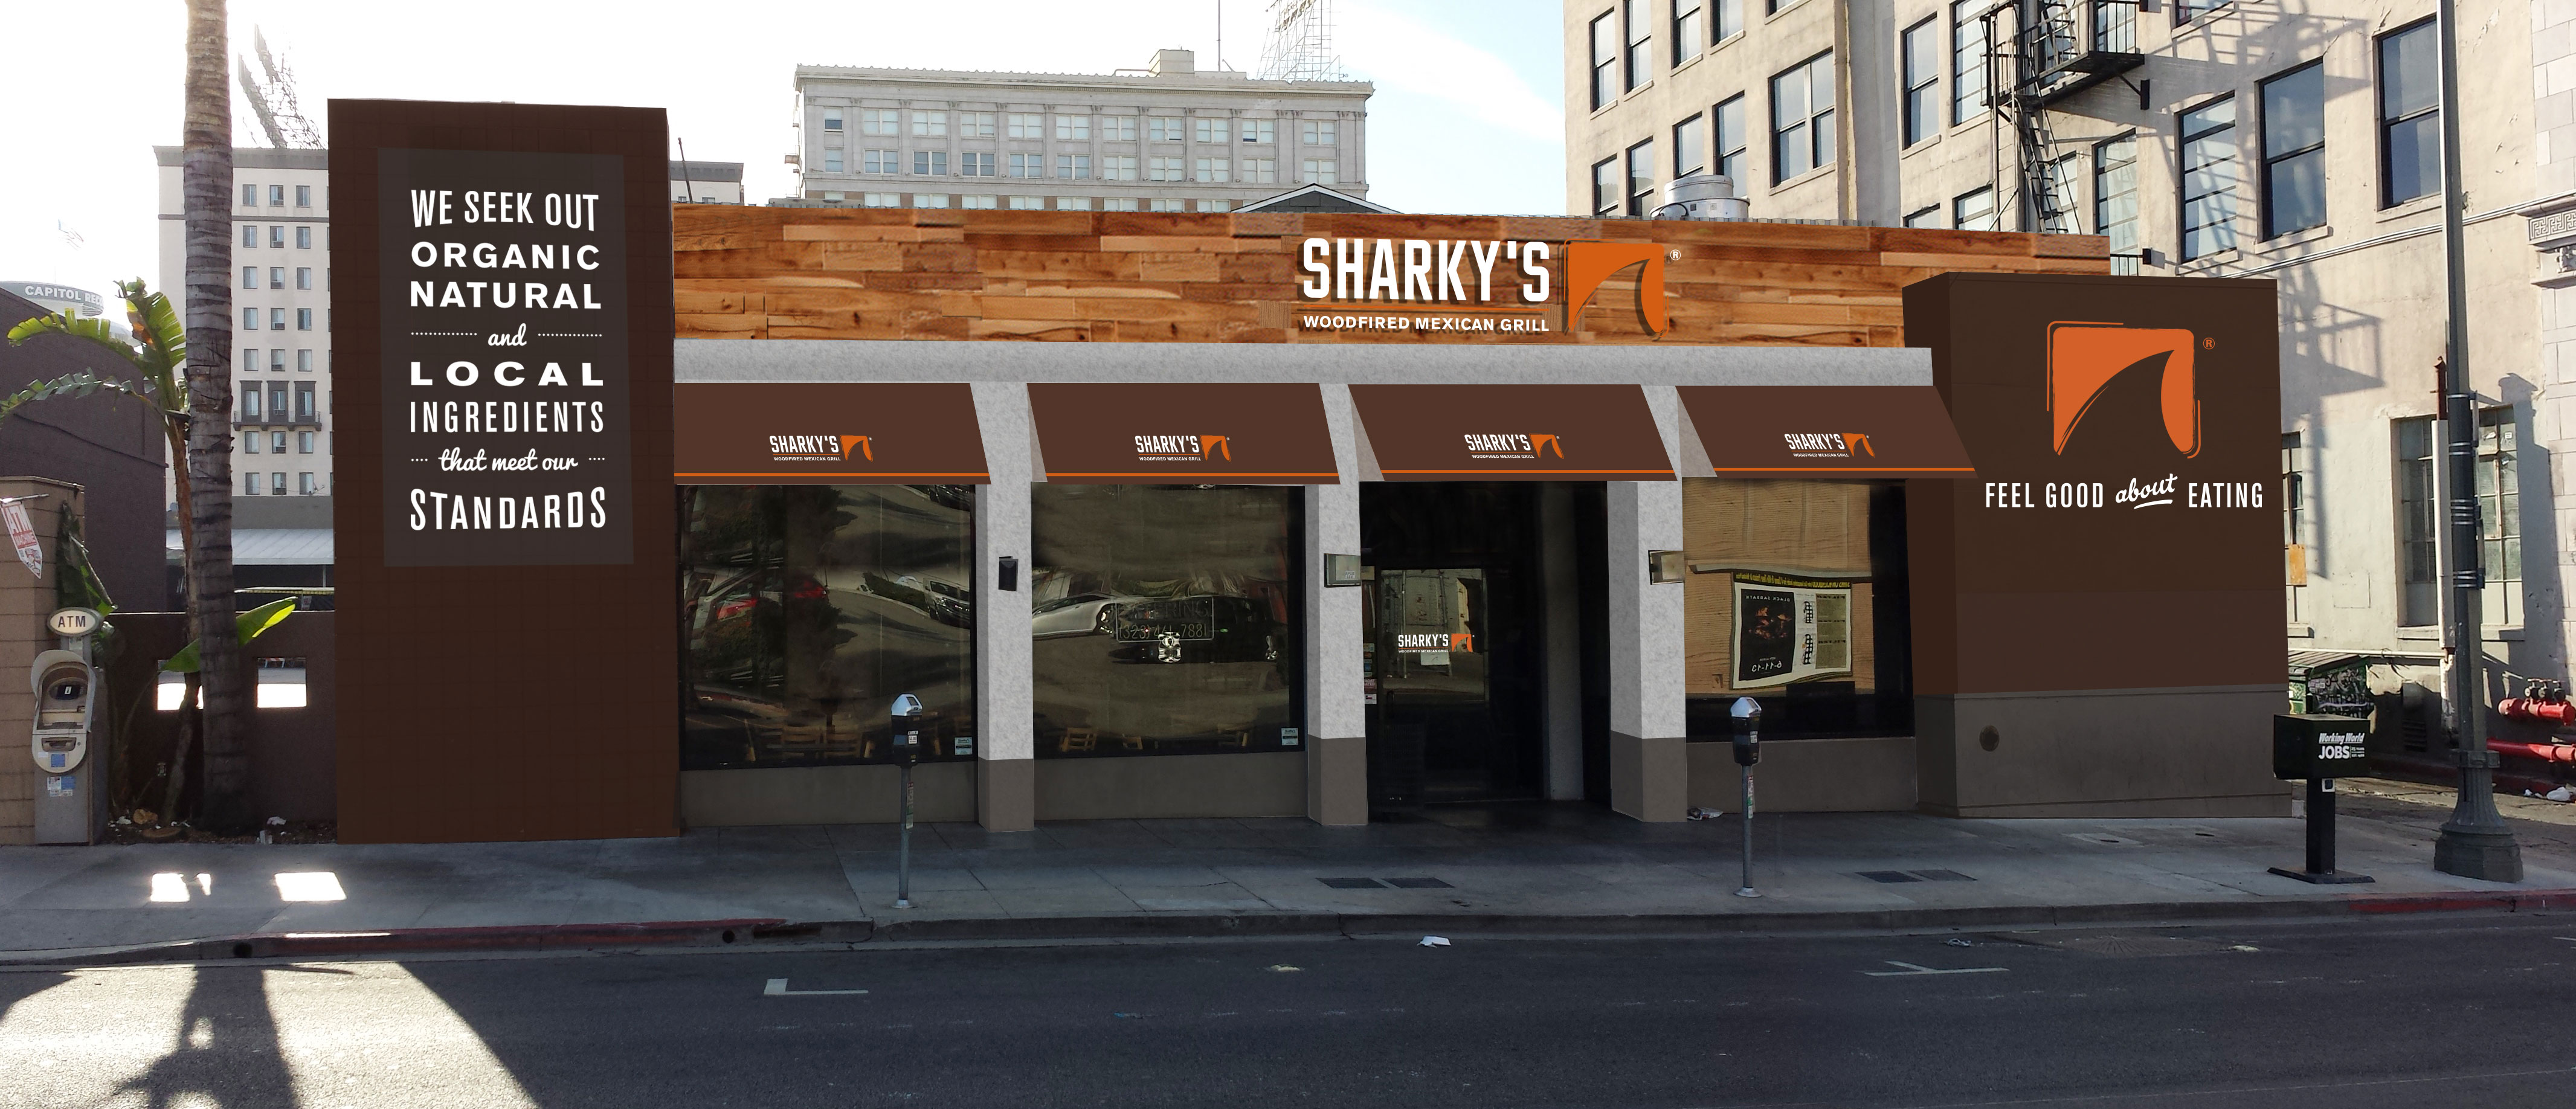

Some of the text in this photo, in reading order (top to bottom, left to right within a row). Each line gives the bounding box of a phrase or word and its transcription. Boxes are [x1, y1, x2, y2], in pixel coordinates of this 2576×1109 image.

[411, 189, 599, 231] WE SEEK OUT
[411, 241, 600, 271] ORGANIC
[1303, 237, 1550, 302] SHARKY'S
[25, 285, 82, 301] CAPITOL
[410, 281, 601, 309] NATURAL
[1303, 315, 1550, 332] WOODFIRED MEXICAN GRILL
[488, 323, 527, 346] and
[411, 361, 604, 387] LOCAL
[410, 401, 604, 433] INGREDIENTS
[769, 435, 839, 453] SHARKY'S
[1135, 435, 1200, 453] SHARKY'S
[1464, 434, 1531, 451] SHARKY'S
[1784, 433, 1845, 450] SHARKY'S
[437, 446, 579, 471] that meet our
[1986, 473, 2262, 508] FEEL GOOD about EATING
[410, 486, 606, 531] STANDARDS
[57, 616, 86, 628] ATM
[1181, 623, 1207, 638] 7881
[1398, 634, 1449, 648] SHARKY'S
[2319, 733, 2365, 745] Working World
[2318, 745, 2350, 759] JOBS
